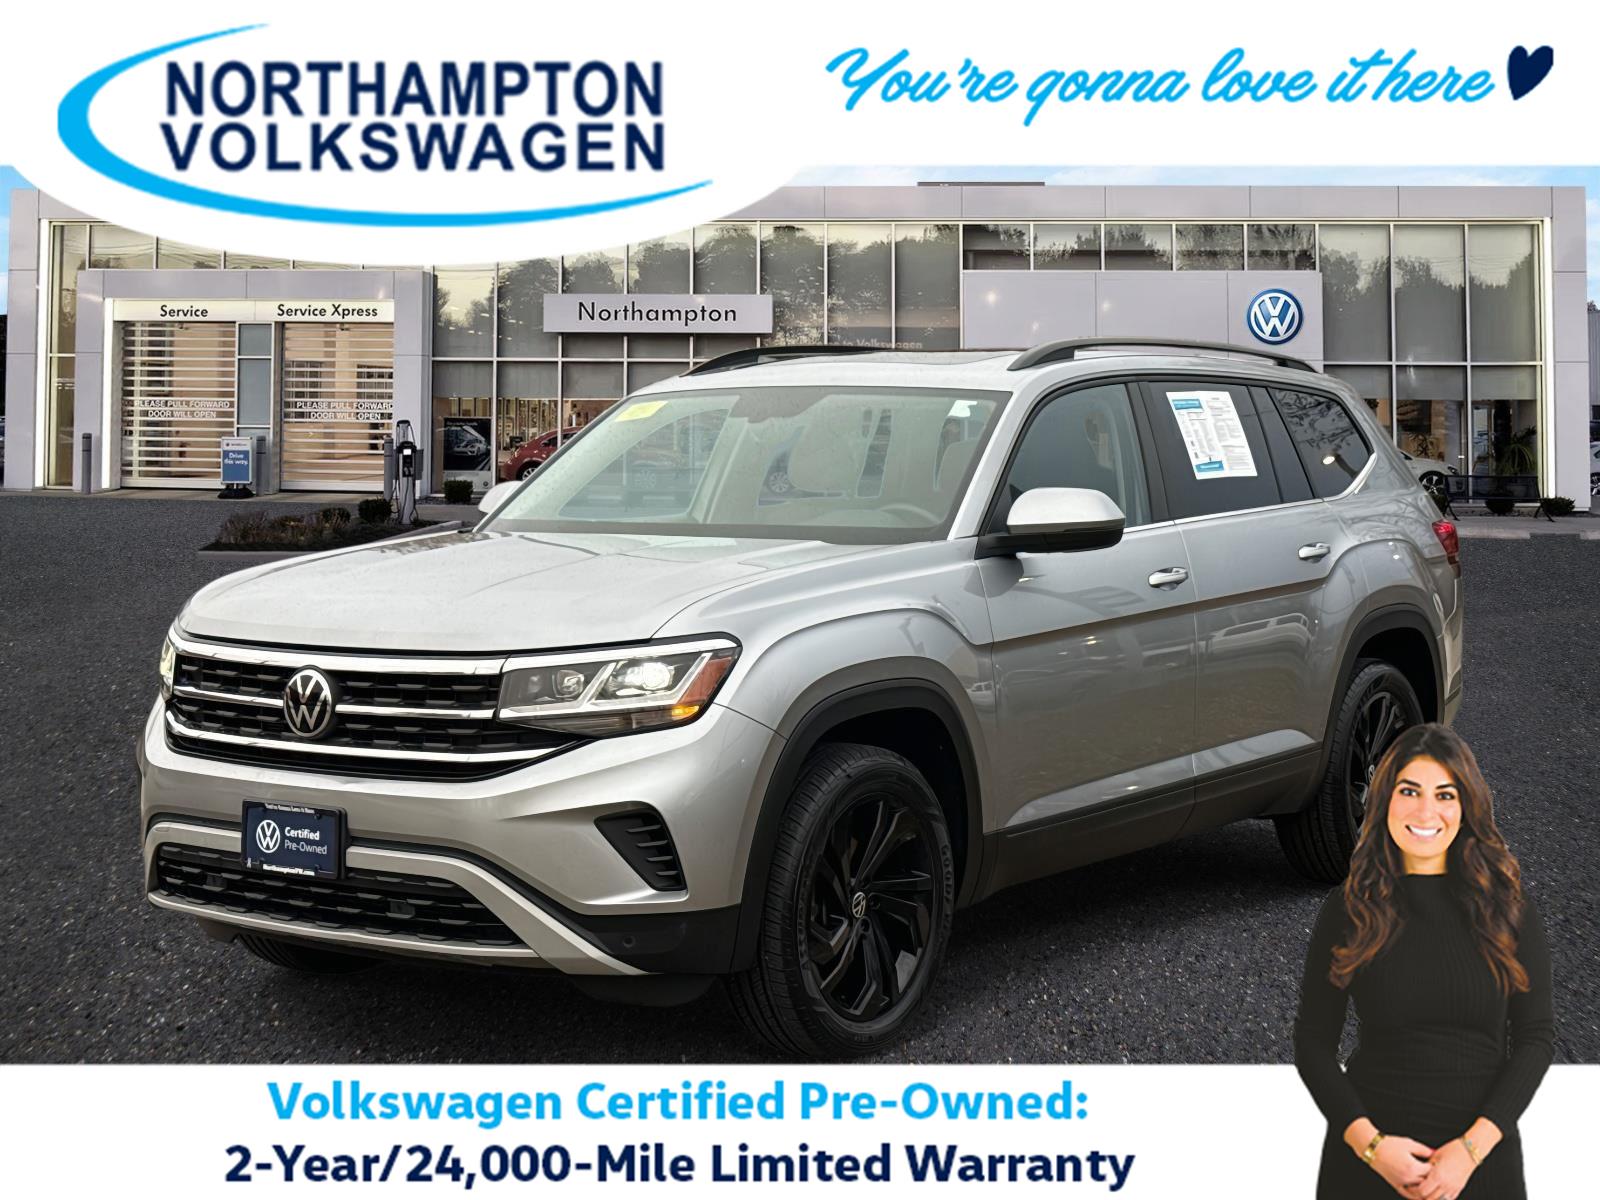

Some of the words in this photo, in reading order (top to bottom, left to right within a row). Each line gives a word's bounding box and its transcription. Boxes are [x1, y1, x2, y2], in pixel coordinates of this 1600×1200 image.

[160, 304, 208, 318] Service
[277, 303, 327, 317] Service
[330, 303, 378, 320] Xpress
[577, 301, 737, 326] Northampton
[134, 400, 166, 408] PLEASE
[167, 400, 188, 408] PULL
[189, 400, 230, 409] FORWARD
[296, 401, 328, 409] PLEASE
[330, 402, 352, 410] PULL
[353, 402, 394, 410] FORWARD
[148, 410, 171, 418] DOOR
[172, 410, 192, 418] WILL
[194, 411, 217, 419] OPEN
[310, 412, 335, 420] DOOR
[336, 412, 356, 420] WILL
[357, 412, 381, 420] OPEN
[285, 827, 320, 840] Certified
[285, 840, 327, 854] Pre-Owned
